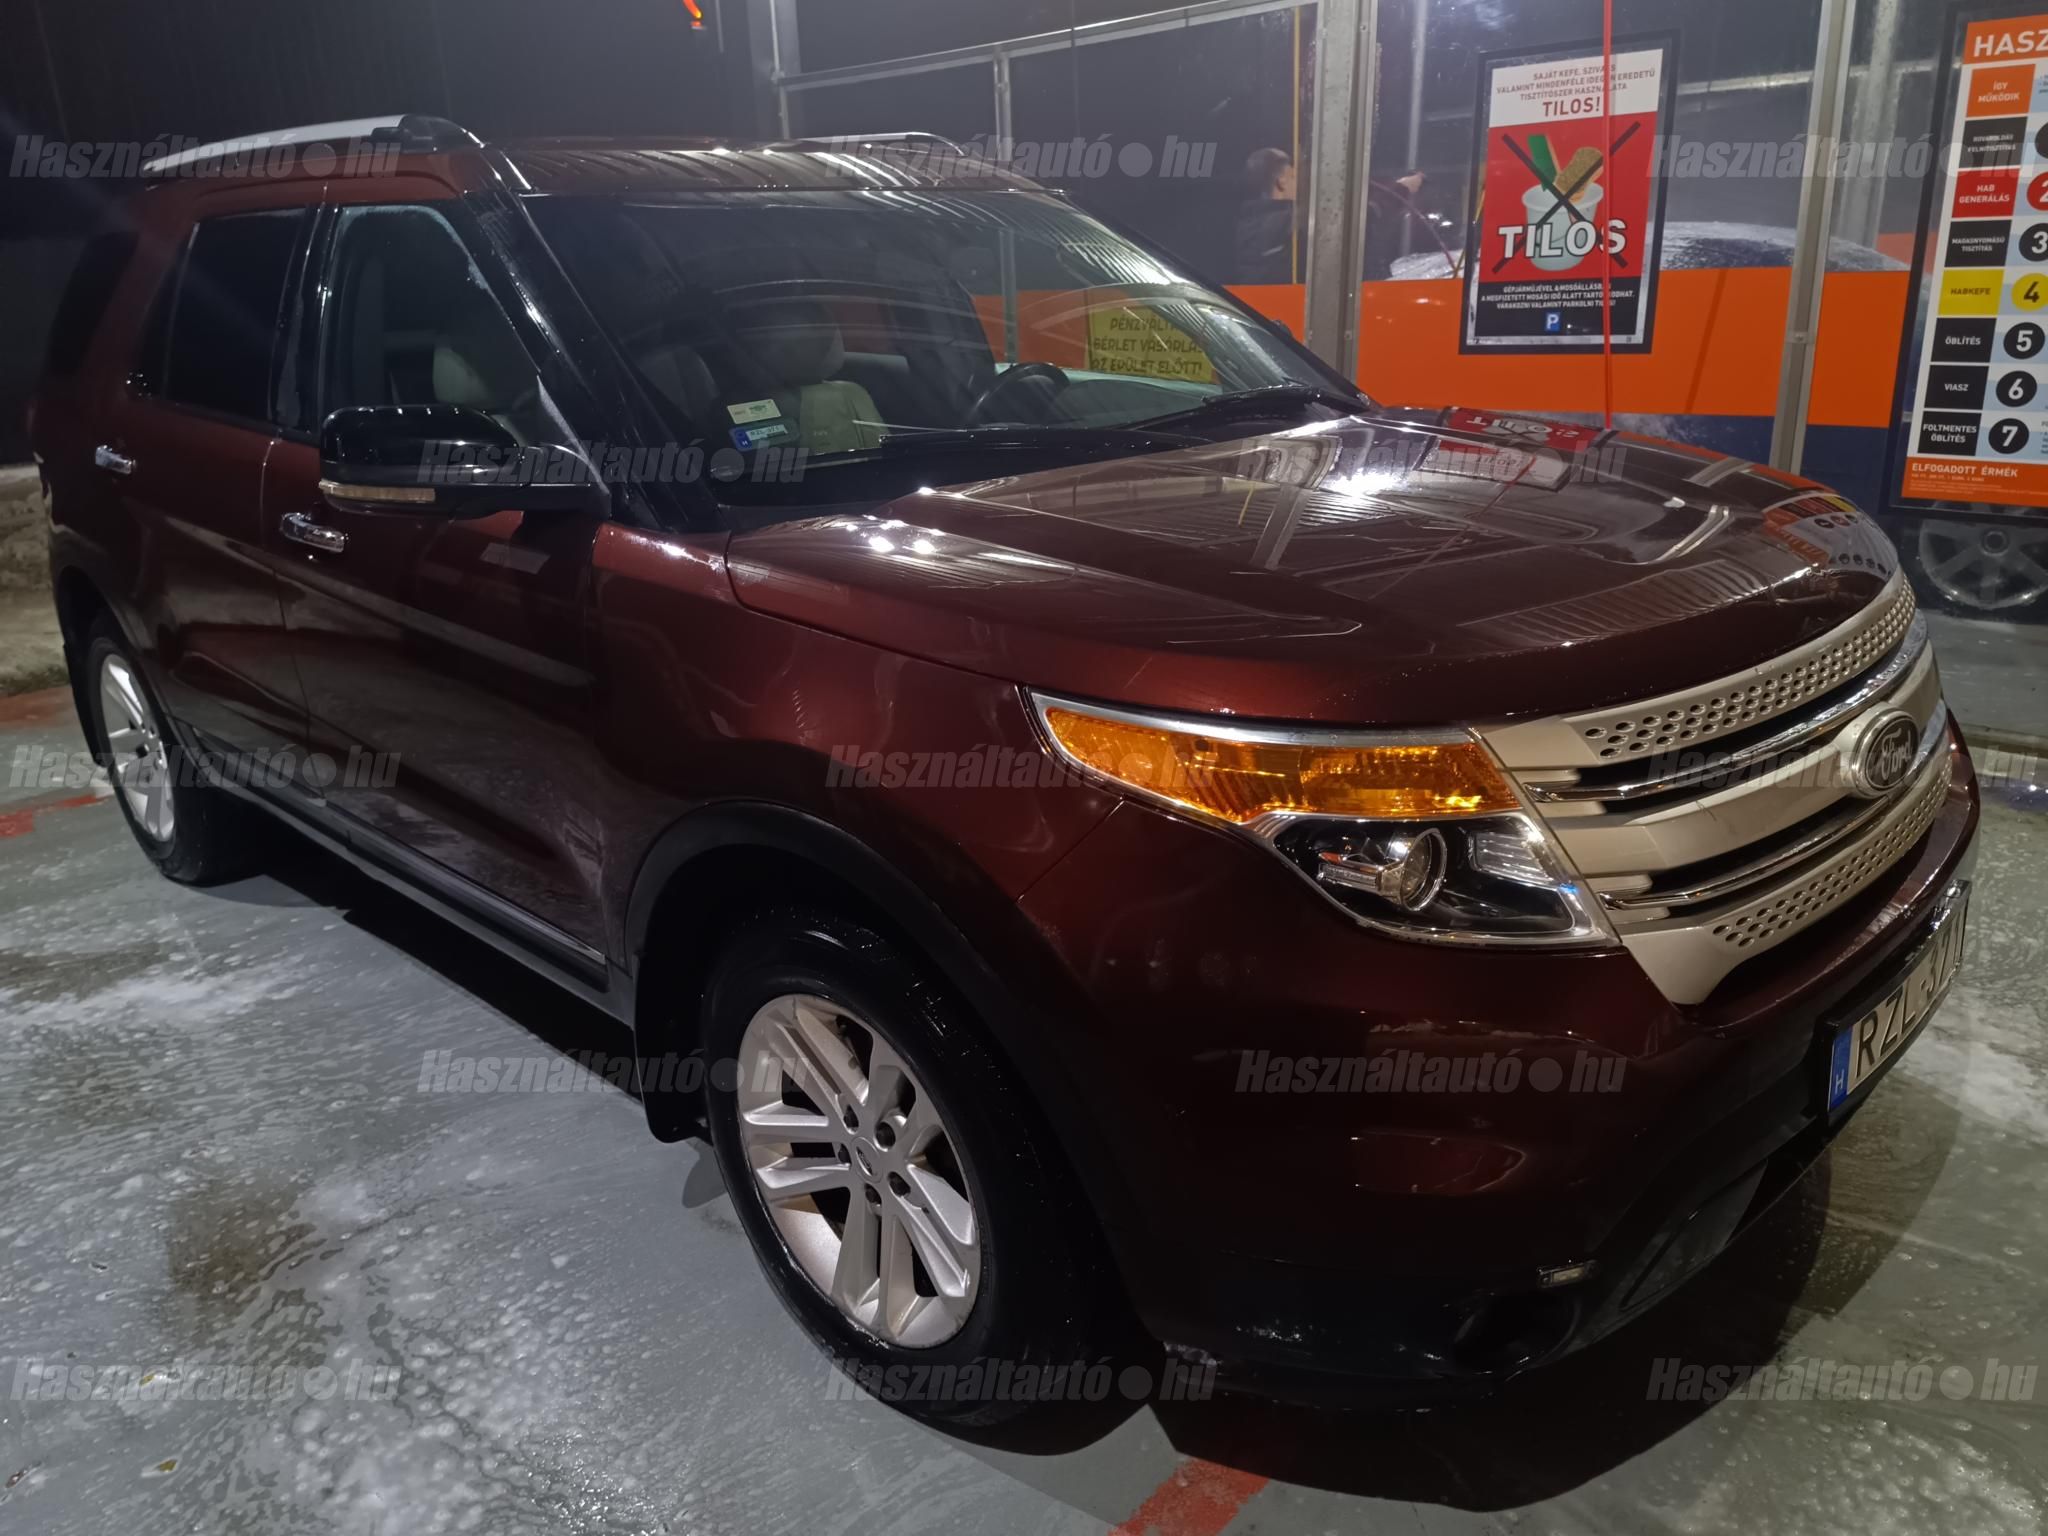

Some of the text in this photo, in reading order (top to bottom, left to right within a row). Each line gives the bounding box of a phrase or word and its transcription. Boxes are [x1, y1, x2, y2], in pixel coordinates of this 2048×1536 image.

[1583, 64, 1616, 75] SZIVAS
[1497, 83, 1535, 94] VALAMINT
[1536, 77, 1584, 89] MINDENFÉLE
[1586, 74, 1616, 84] IDEGN
[1542, 96, 1600, 117] TILOS!
[1959, 193, 2010, 204] GENERÁLÁS
[1976, 184, 1995, 193] HAB
[1497, 218, 1628, 260] TILOS
[2031, 231, 2048, 254] 3
[1950, 287, 1991, 296] HABKEFE
[2023, 281, 2040, 303] 4
[1945, 335, 1981, 346] ÖBLÍTÉS
[2016, 330, 2033, 352] 5
[1944, 383, 1969, 392] VIASZ
[2007, 378, 2024, 400] 6
[1923, 423, 1977, 433] FOLTMENTES
[1930, 432, 1966, 443] ÖBLÍTÉS
[2001, 425, 2018, 447] 7
[1911, 462, 1977, 475] ELFOGADOTT
[1981, 463, 2018, 478] ÉRMÉK
[1881, 727, 1912, 780] Ford
[1835, 1068, 1845, 1090] H
